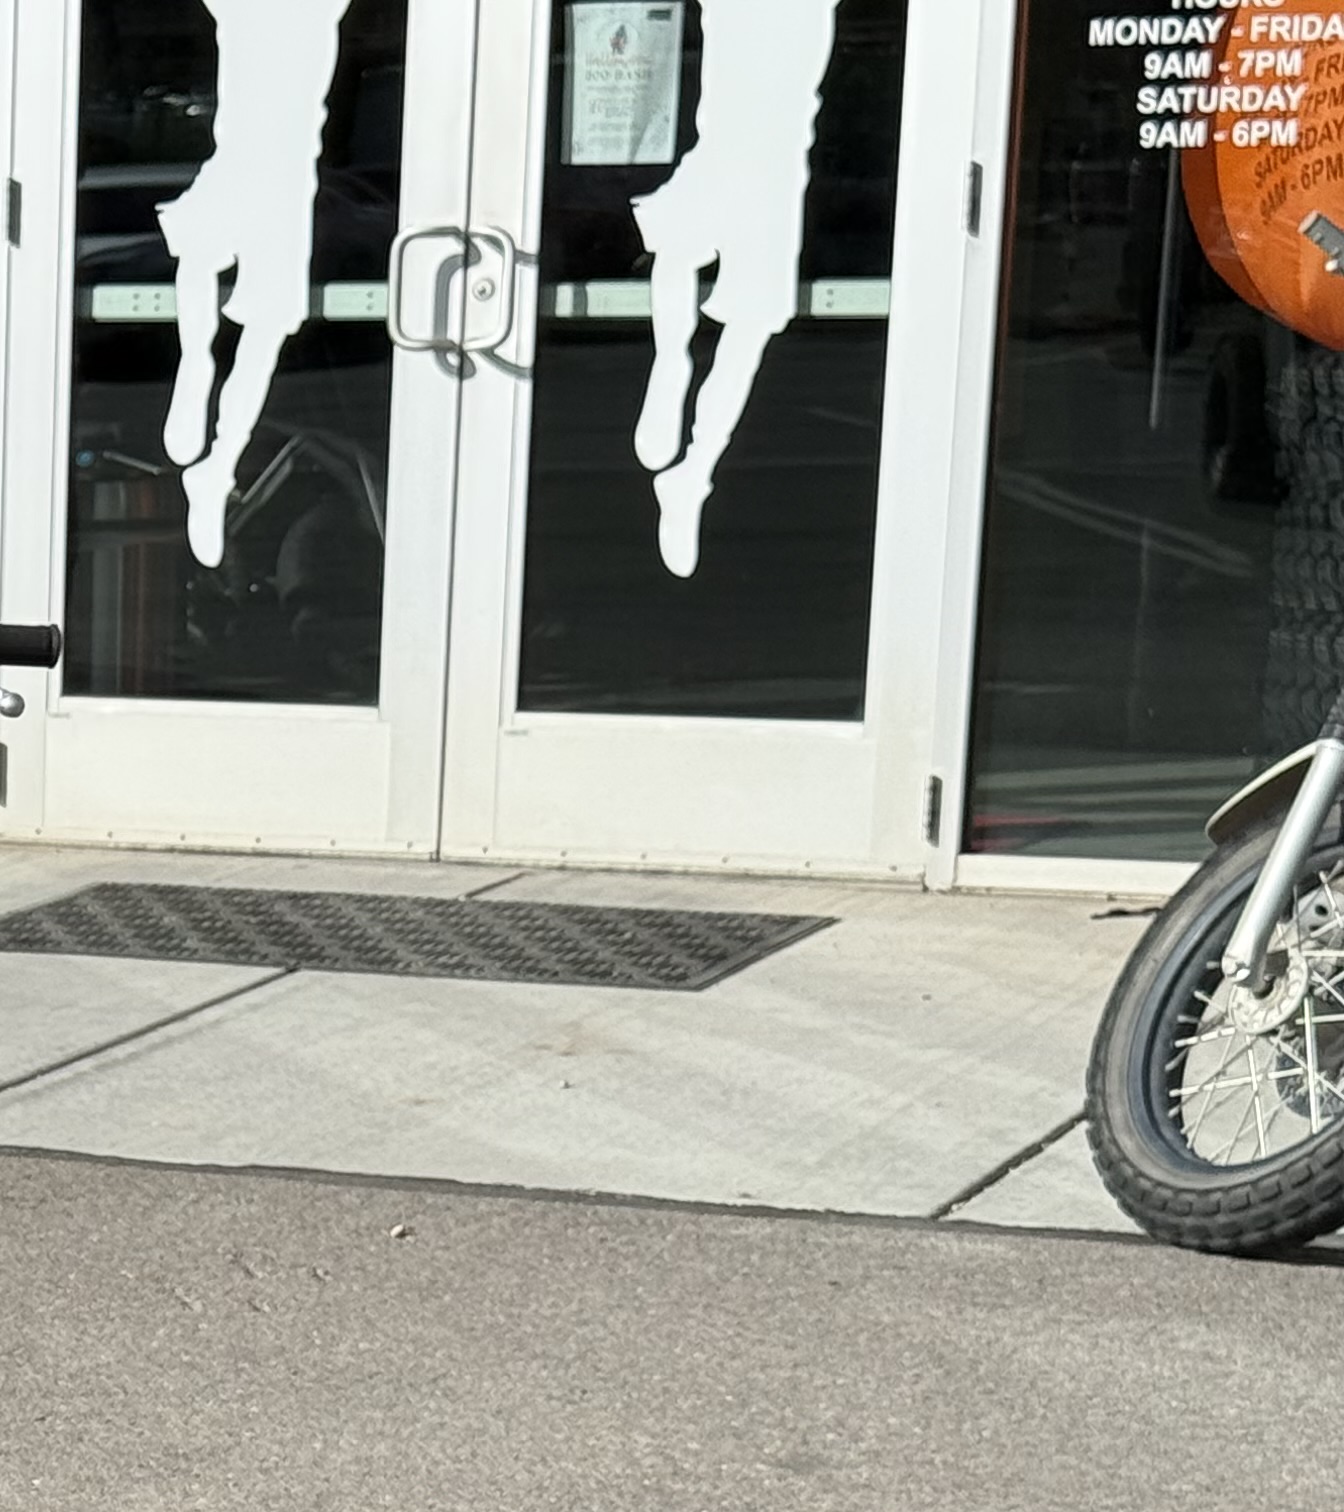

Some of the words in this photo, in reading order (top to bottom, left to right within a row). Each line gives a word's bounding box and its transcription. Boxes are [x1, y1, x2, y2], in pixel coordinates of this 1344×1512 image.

[1088, 15, 1226, 46] MONDAY
[1231, 26, 1245, 38] -
[1249, 14, 1344, 42] FRIDA
[1144, 50, 1211, 80] 9AM
[1237, 48, 1303, 77] 7PM
[1136, 83, 1309, 114] SATURDAY
[1139, 120, 1208, 149] 9AM
[1231, 119, 1298, 147] 6PM
